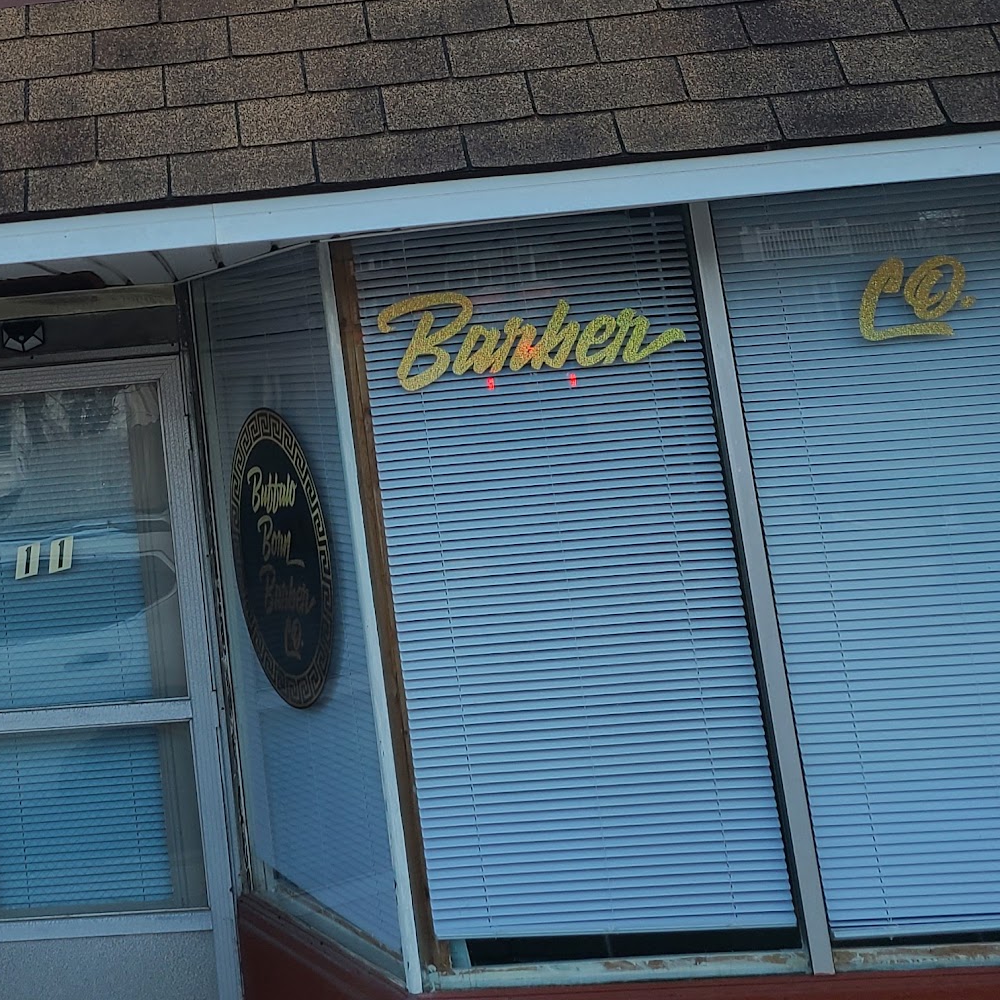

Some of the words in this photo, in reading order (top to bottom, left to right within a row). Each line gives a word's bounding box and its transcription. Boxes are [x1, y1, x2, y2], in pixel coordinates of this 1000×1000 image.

[377, 291, 686, 391] Barber
[247, 466, 297, 514] Buffalo
[257, 515, 304, 568] Born
